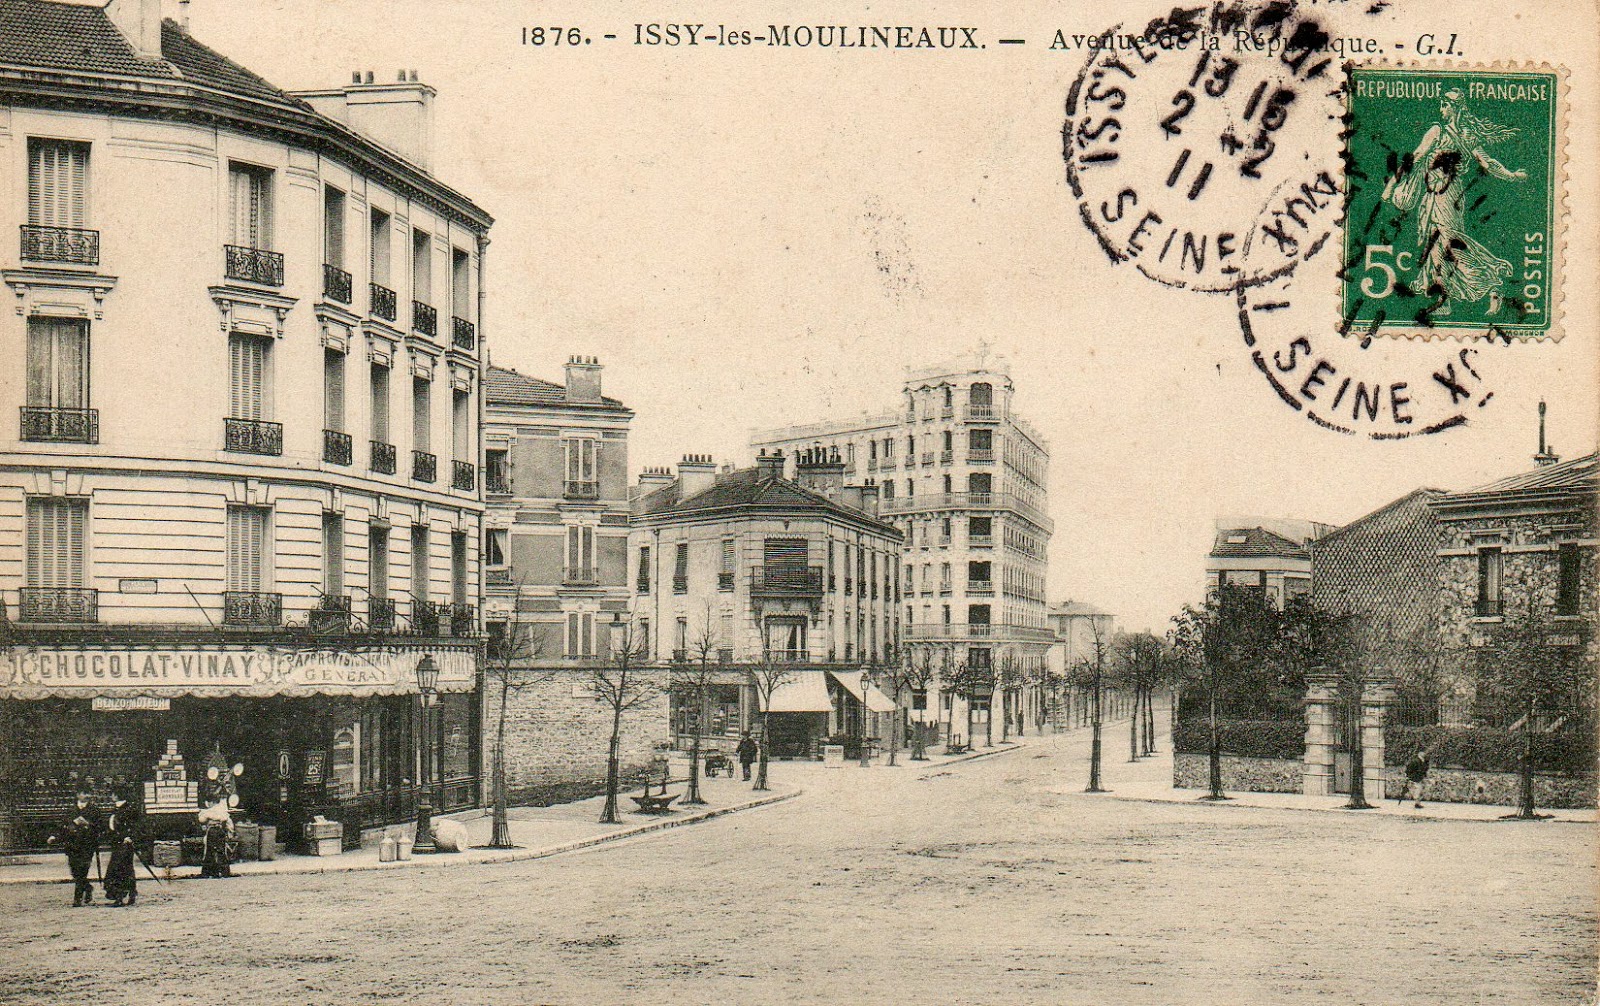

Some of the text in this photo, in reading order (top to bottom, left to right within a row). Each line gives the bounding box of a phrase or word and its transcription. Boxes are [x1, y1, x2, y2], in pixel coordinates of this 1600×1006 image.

[1468, 81, 1548, 103] FRANÇAISE
[1100, 186, 1240, 276] SEINE
[1523, 231, 1544, 315] POSTES
[1273, 335, 1413, 425] SEINE
[40, 654, 257, 679] CHOCOLAT VINAY
